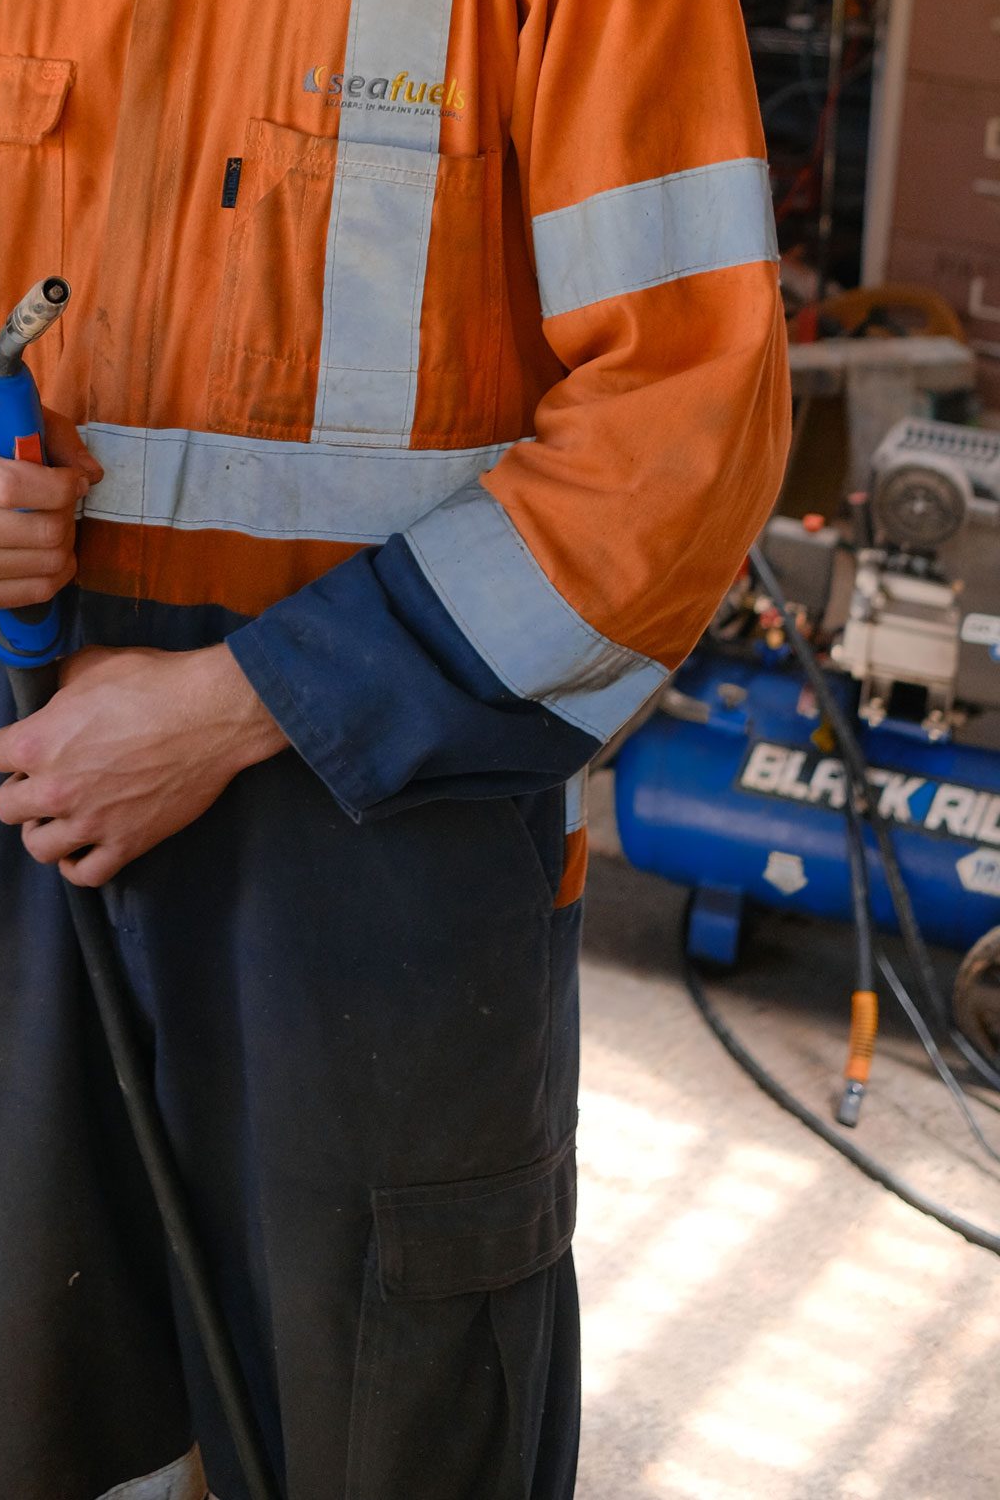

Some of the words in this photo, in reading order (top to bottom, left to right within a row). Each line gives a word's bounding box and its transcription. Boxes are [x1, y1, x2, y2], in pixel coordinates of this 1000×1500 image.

[328, 71, 466, 110] seafuels
[365, 102, 376, 111] IN
[378, 104, 411, 115] MARINE
[414, 107, 436, 117] FUEL
[439, 110, 464, 122] SUPPLY
[741, 742, 926, 824] BLAK
